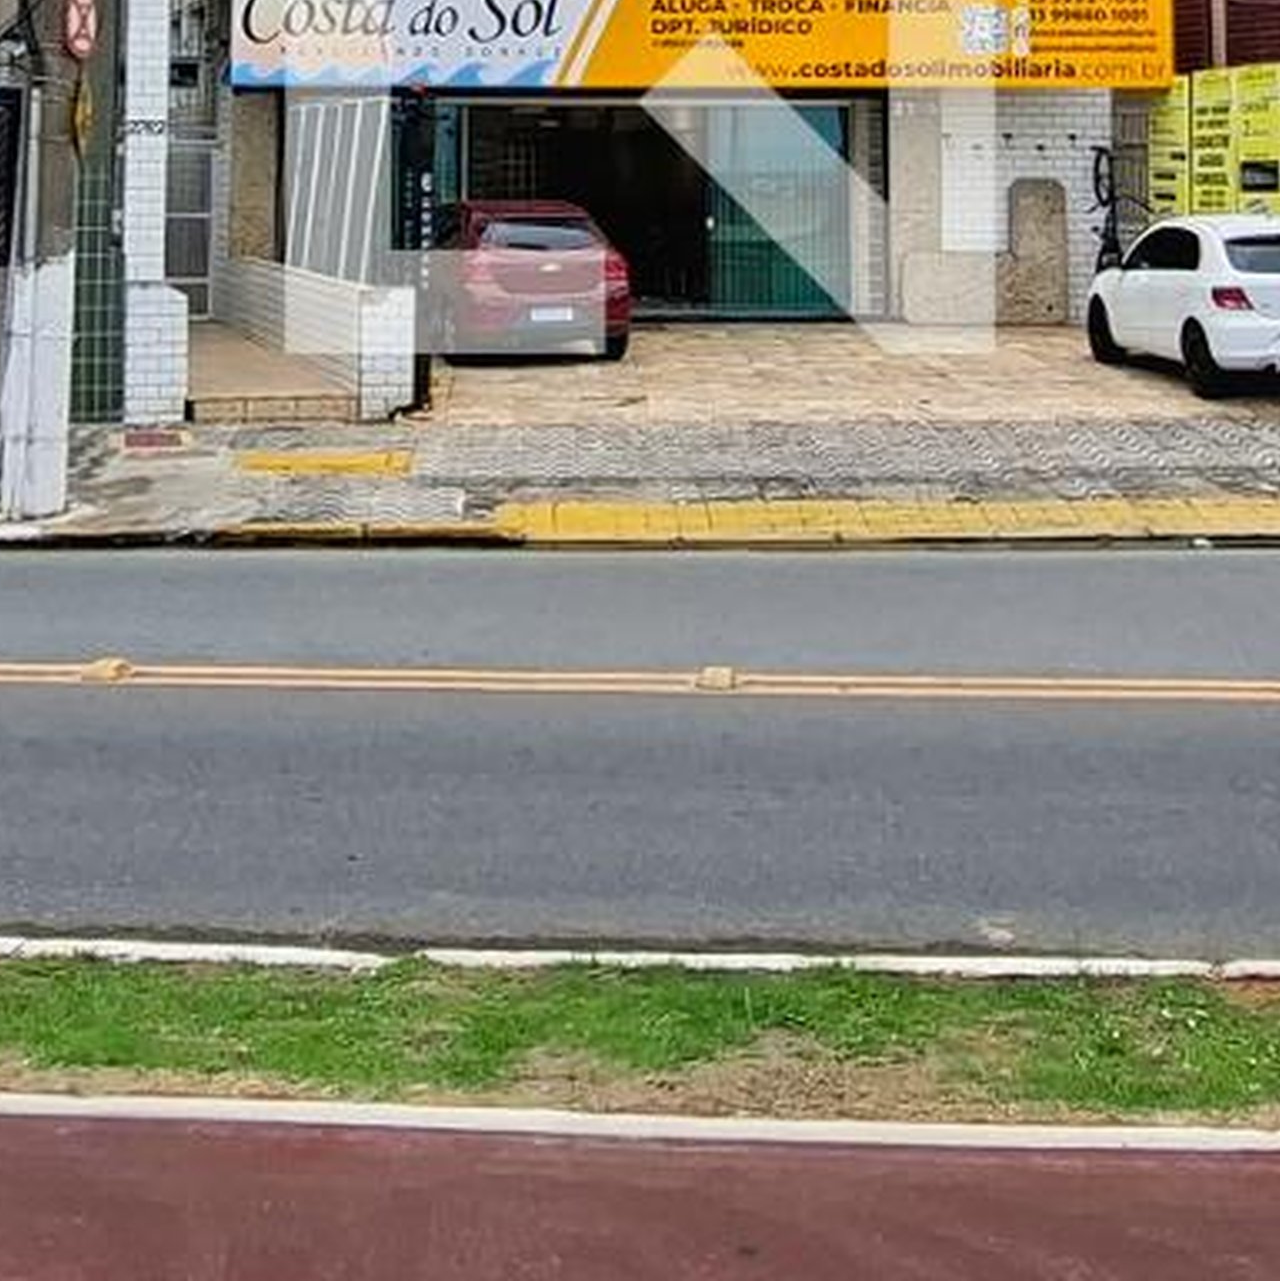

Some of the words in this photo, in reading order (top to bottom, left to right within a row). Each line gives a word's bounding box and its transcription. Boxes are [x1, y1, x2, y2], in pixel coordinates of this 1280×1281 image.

[651, 19, 700, 35] DPT.
[705, 16, 813, 35] JURÍDICO
[728, 58, 1167, 79] www.costadosolimobiliaria.com.br
